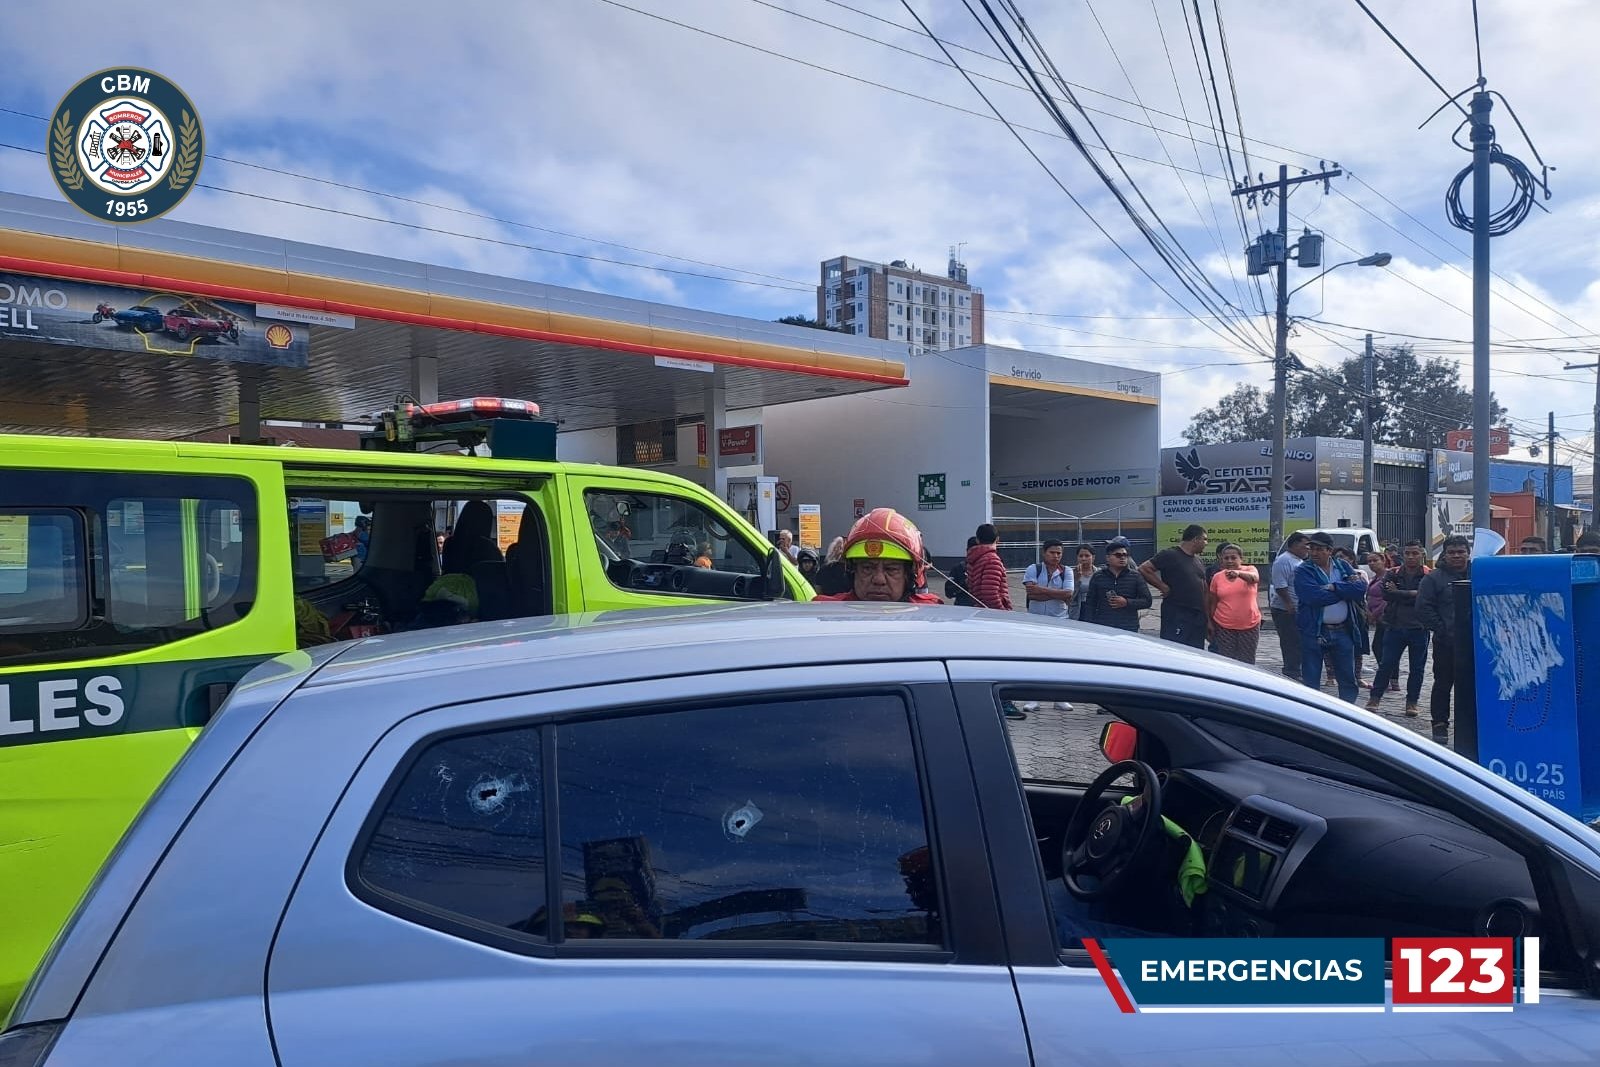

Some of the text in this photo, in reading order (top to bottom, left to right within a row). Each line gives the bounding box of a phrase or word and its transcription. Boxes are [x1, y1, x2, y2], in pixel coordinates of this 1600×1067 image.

[1011, 366, 1042, 380] Servicio
[1284, 450, 1313, 461] NICO
[1214, 466, 1272, 478] CEMENT
[1453, 470, 1473, 482] CEMENT
[1022, 479, 1069, 489] SERVICIOS
[1071, 477, 1084, 487] DE
[1086, 475, 1121, 485] MOTOR
[1207, 496, 1249, 505] SERVICIOS
[1542, 787, 1566, 800] PAÍS
